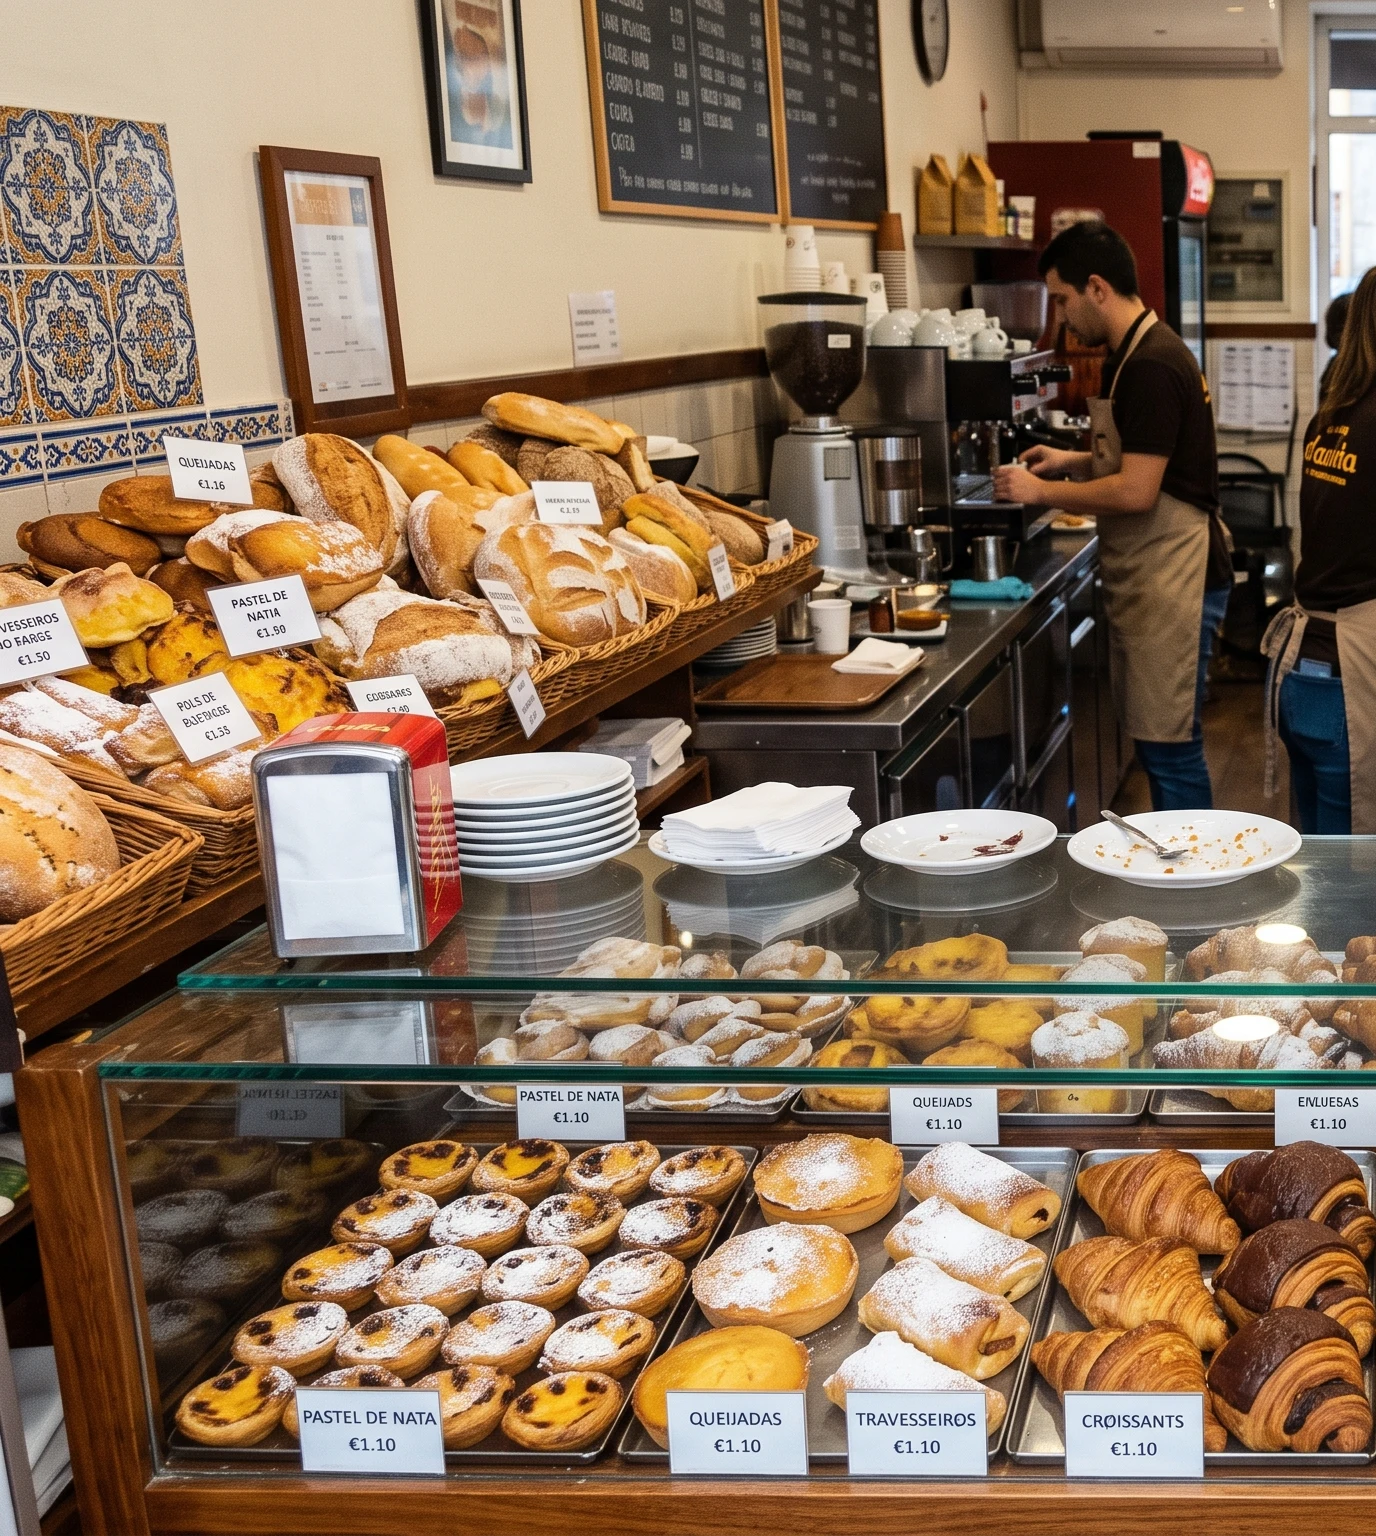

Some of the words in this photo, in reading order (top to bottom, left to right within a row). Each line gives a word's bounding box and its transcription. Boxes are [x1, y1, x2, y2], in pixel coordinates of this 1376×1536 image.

[178, 456, 236, 471] QUEIJADAS
[198, 479, 226, 491] €1.16
[231, 593, 272, 609] PASTEL
[272, 590, 288, 602] DE
[246, 607, 282, 622] NATIA
[18, 650, 51, 666] €1.50
[176, 696, 203, 712] POLS
[201, 691, 217, 704] DE
[520, 1090, 565, 1102] PASTEL
[567, 1090, 584, 1102] DE
[587, 1090, 620, 1102] NATA
[907, 1096, 973, 1109] QUEIJADS
[552, 1111, 589, 1124] €1.10
[926, 1118, 962, 1130] €1.10
[1310, 1118, 1347, 1130] €1.10
[303, 1410, 362, 1425] PASTEL
[366, 1411, 388, 1425] DE
[393, 1411, 437, 1426] NATA
[689, 1411, 782, 1427] QUEIJADAS
[855, 1412, 977, 1428] TRAVESSEIROS
[348, 1437, 396, 1452] €1.10
[713, 1438, 761, 1453] €1.10
[893, 1439, 941, 1454] €1.10
[1110, 1441, 1158, 1456] €1.10
